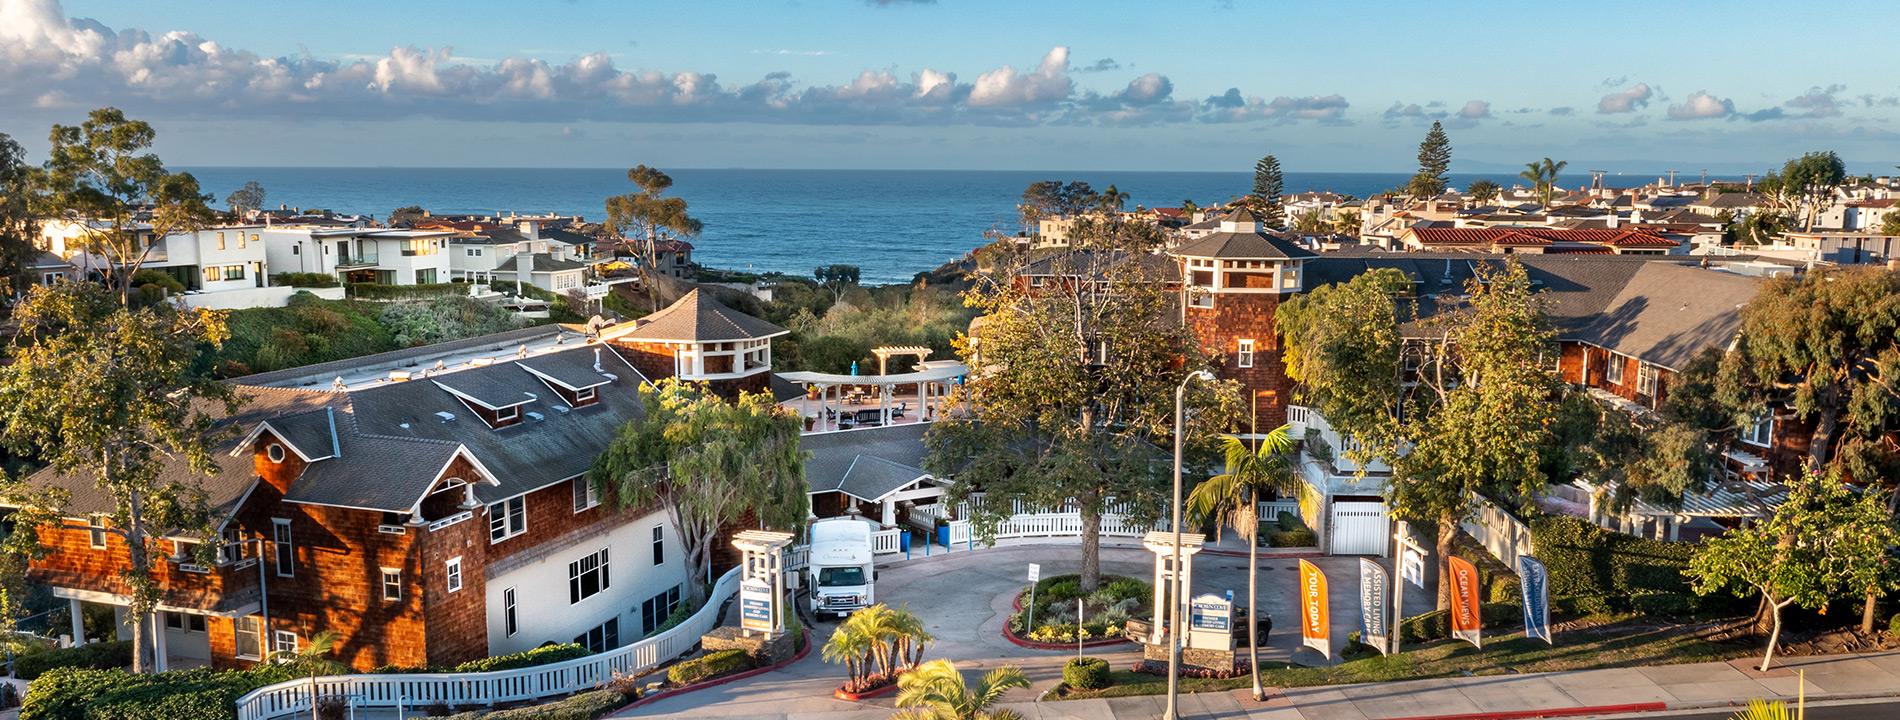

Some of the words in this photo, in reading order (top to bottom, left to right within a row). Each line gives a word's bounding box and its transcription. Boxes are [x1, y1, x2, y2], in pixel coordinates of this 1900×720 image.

[1308, 571, 1318, 598] TOUR
[1363, 567, 1372, 575] &
[1459, 569, 1469, 598] OCEAN
[1363, 577, 1372, 612] MEMORY
[1373, 568, 1382, 606] ASSISTED
[1532, 563, 1543, 624] EXTRAORDINARY
[1310, 600, 1320, 634] TODAY
[1372, 608, 1381, 634] LIVING
[1461, 599, 1470, 626] VIEWS
